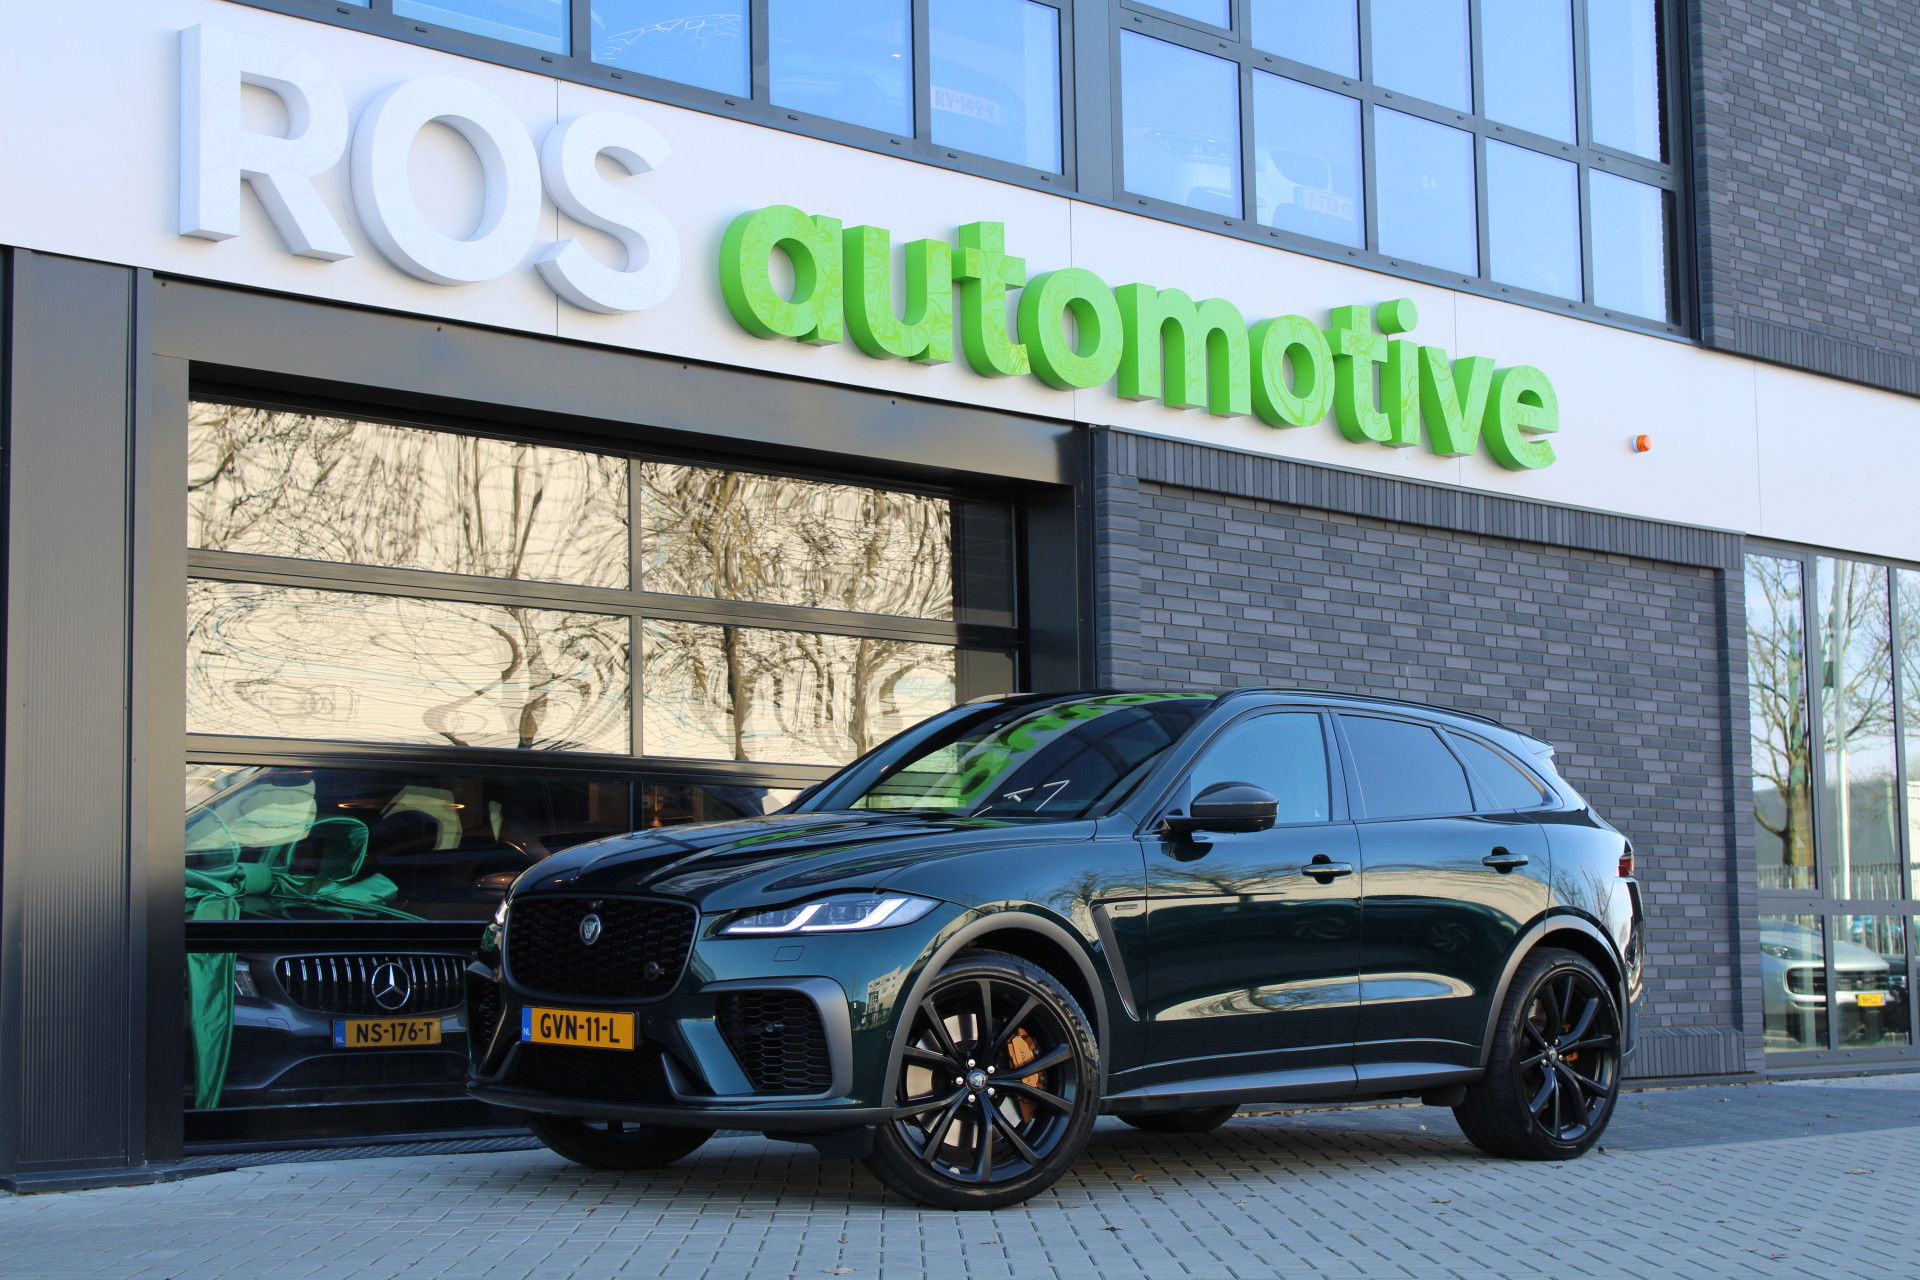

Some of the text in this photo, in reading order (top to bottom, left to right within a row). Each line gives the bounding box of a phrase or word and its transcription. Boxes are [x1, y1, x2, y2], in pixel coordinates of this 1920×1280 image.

[179, 22, 1559, 470] ROS automotive
[356, 1022, 433, 1043] NS-176-T
[540, 1013, 620, 1043] GVN-11-L
